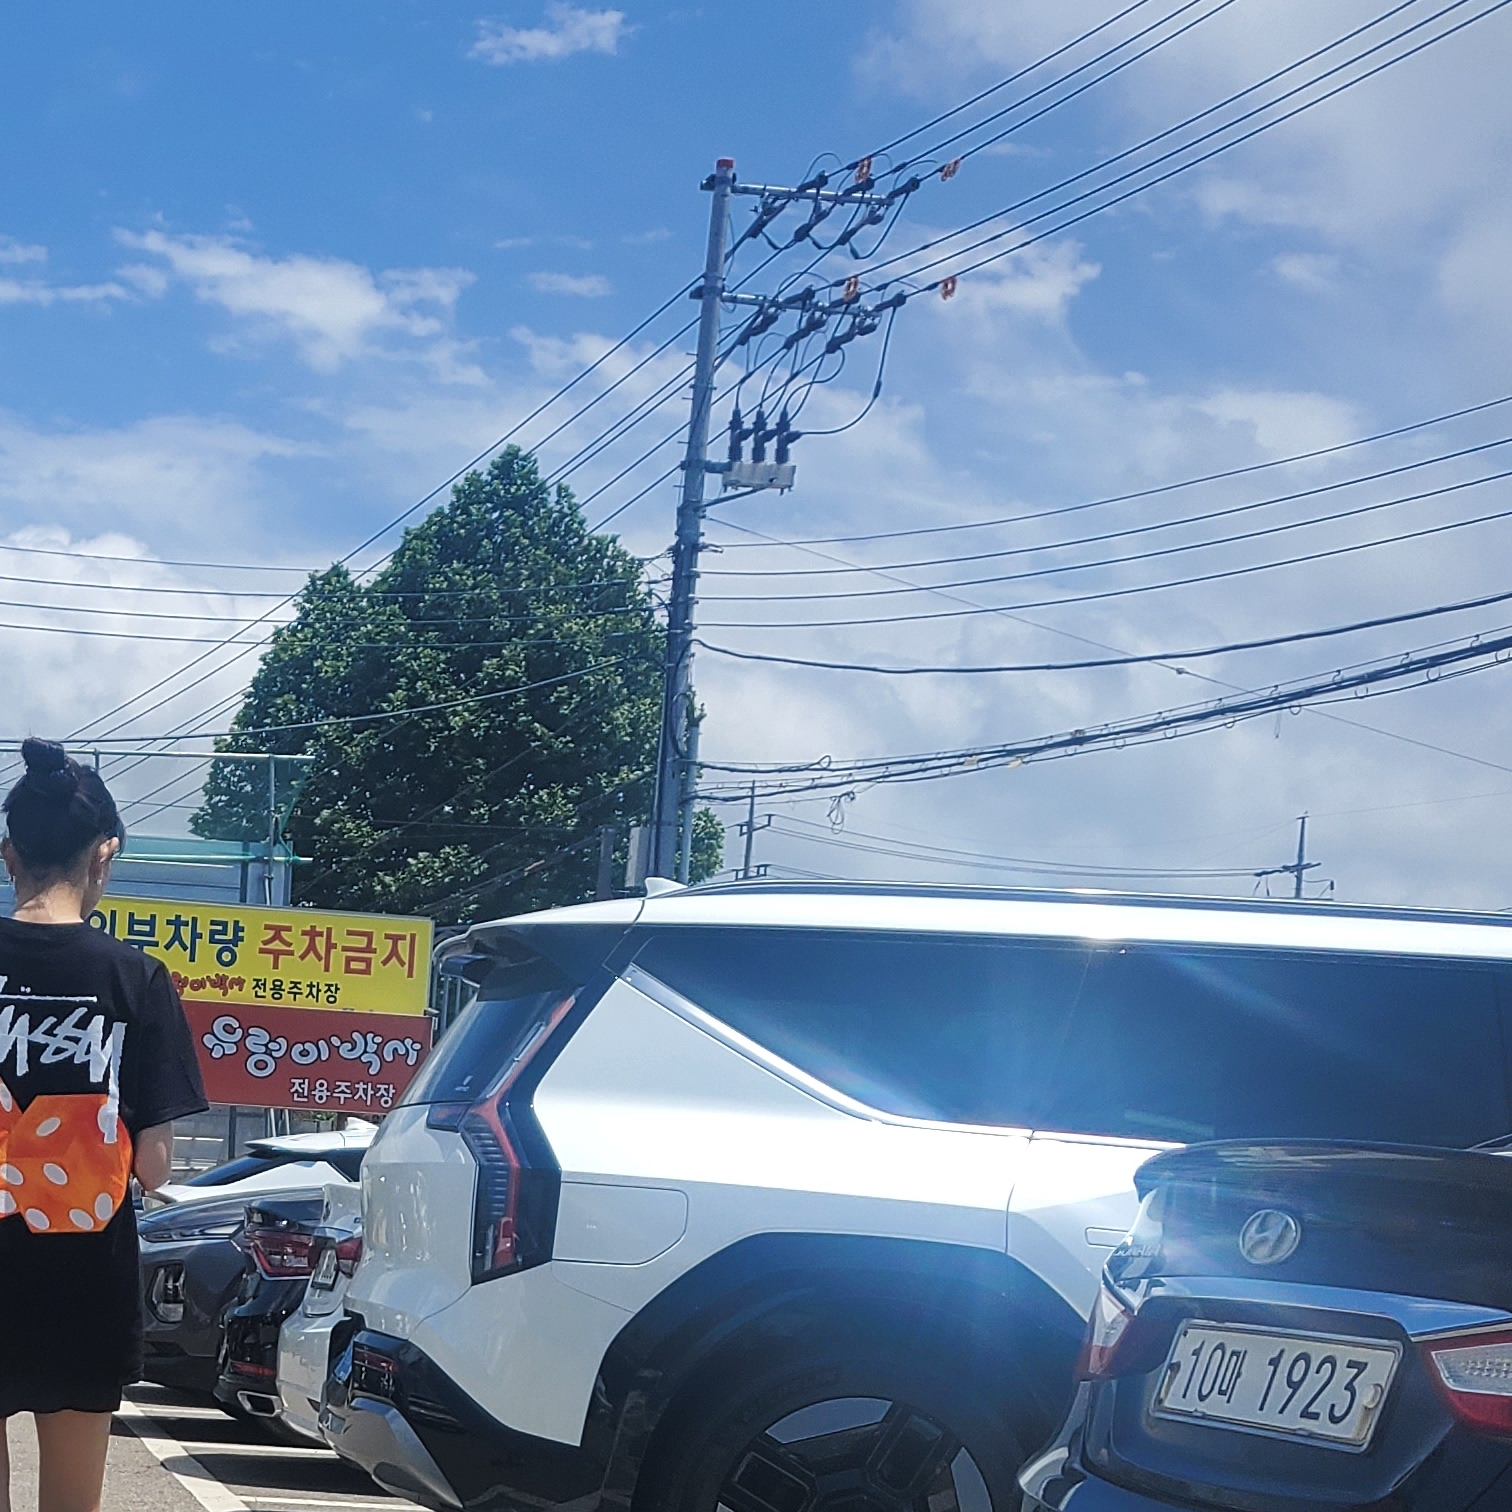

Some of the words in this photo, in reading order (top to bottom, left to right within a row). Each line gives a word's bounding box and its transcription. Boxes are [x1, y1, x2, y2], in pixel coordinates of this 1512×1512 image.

[257, 923, 417, 979] 주차금지
[170, 971, 247, 997] 렁이박사
[251, 977, 341, 1004] 전용주차장
[289, 1078, 396, 1108] 전용주차장
[1182, 1340, 1248, 1404] 10마
[1257, 1347, 1370, 1425] 1923
